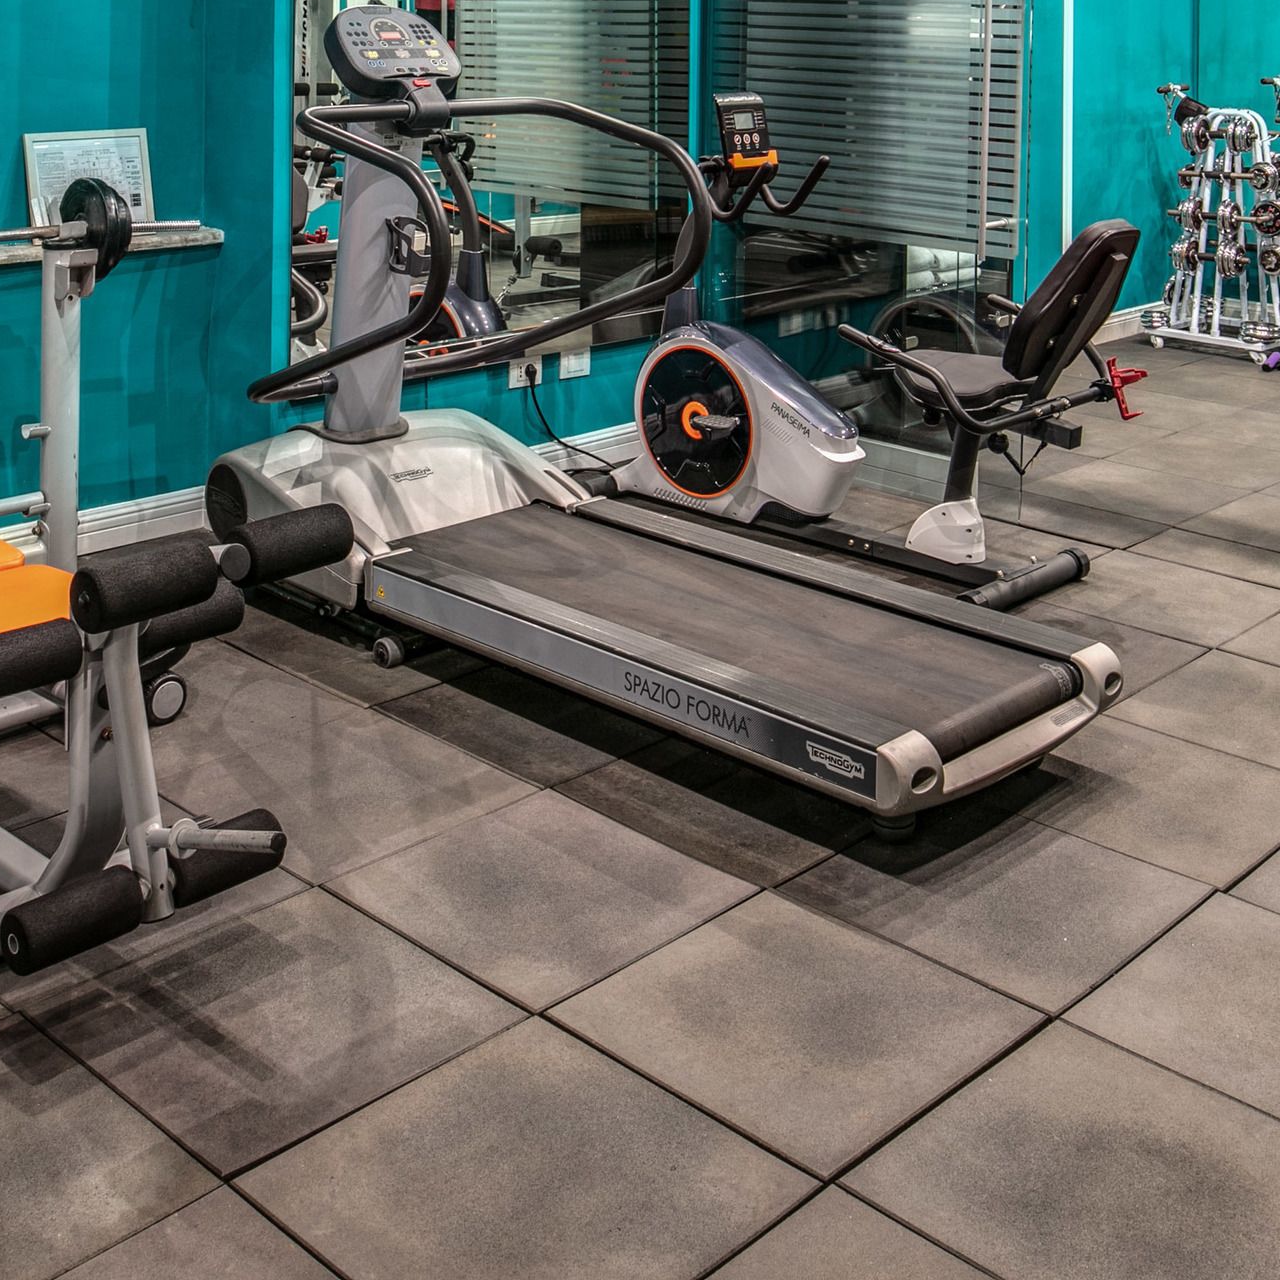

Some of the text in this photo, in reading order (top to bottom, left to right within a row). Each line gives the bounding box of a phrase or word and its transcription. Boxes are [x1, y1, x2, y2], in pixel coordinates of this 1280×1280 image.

[770, 401, 811, 438] PANASEIMA
[624, 671, 750, 739] SPAZIO FORMA
